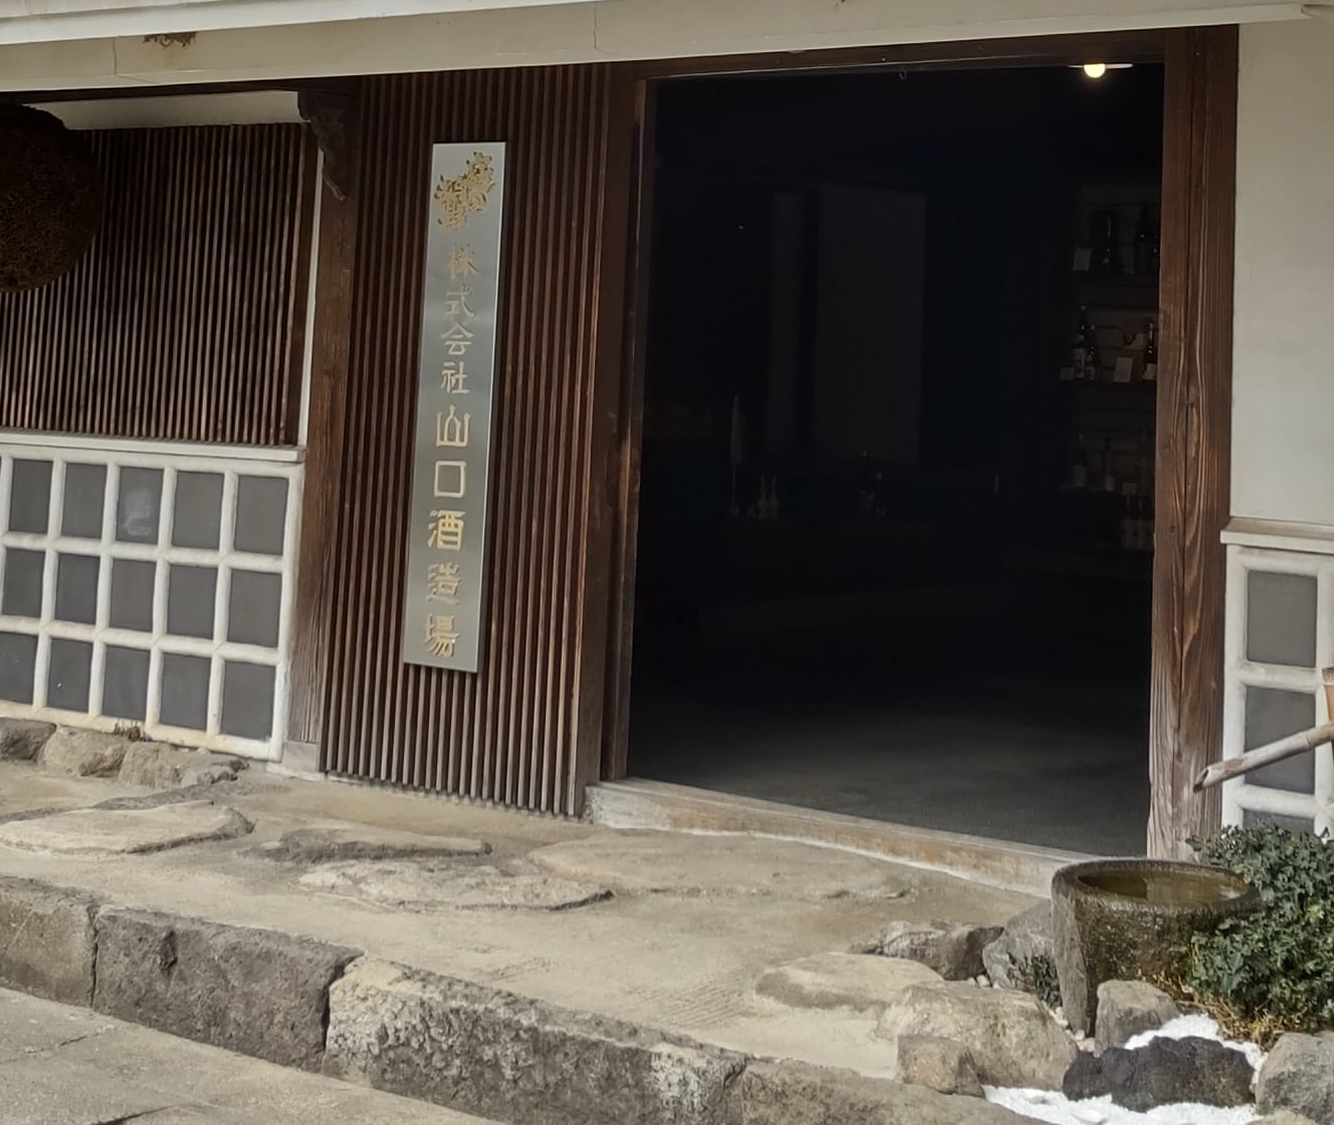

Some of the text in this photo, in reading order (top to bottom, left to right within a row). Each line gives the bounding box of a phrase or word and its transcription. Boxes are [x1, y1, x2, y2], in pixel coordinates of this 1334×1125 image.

[424, 243, 479, 658] 株式会社山口酒造場
